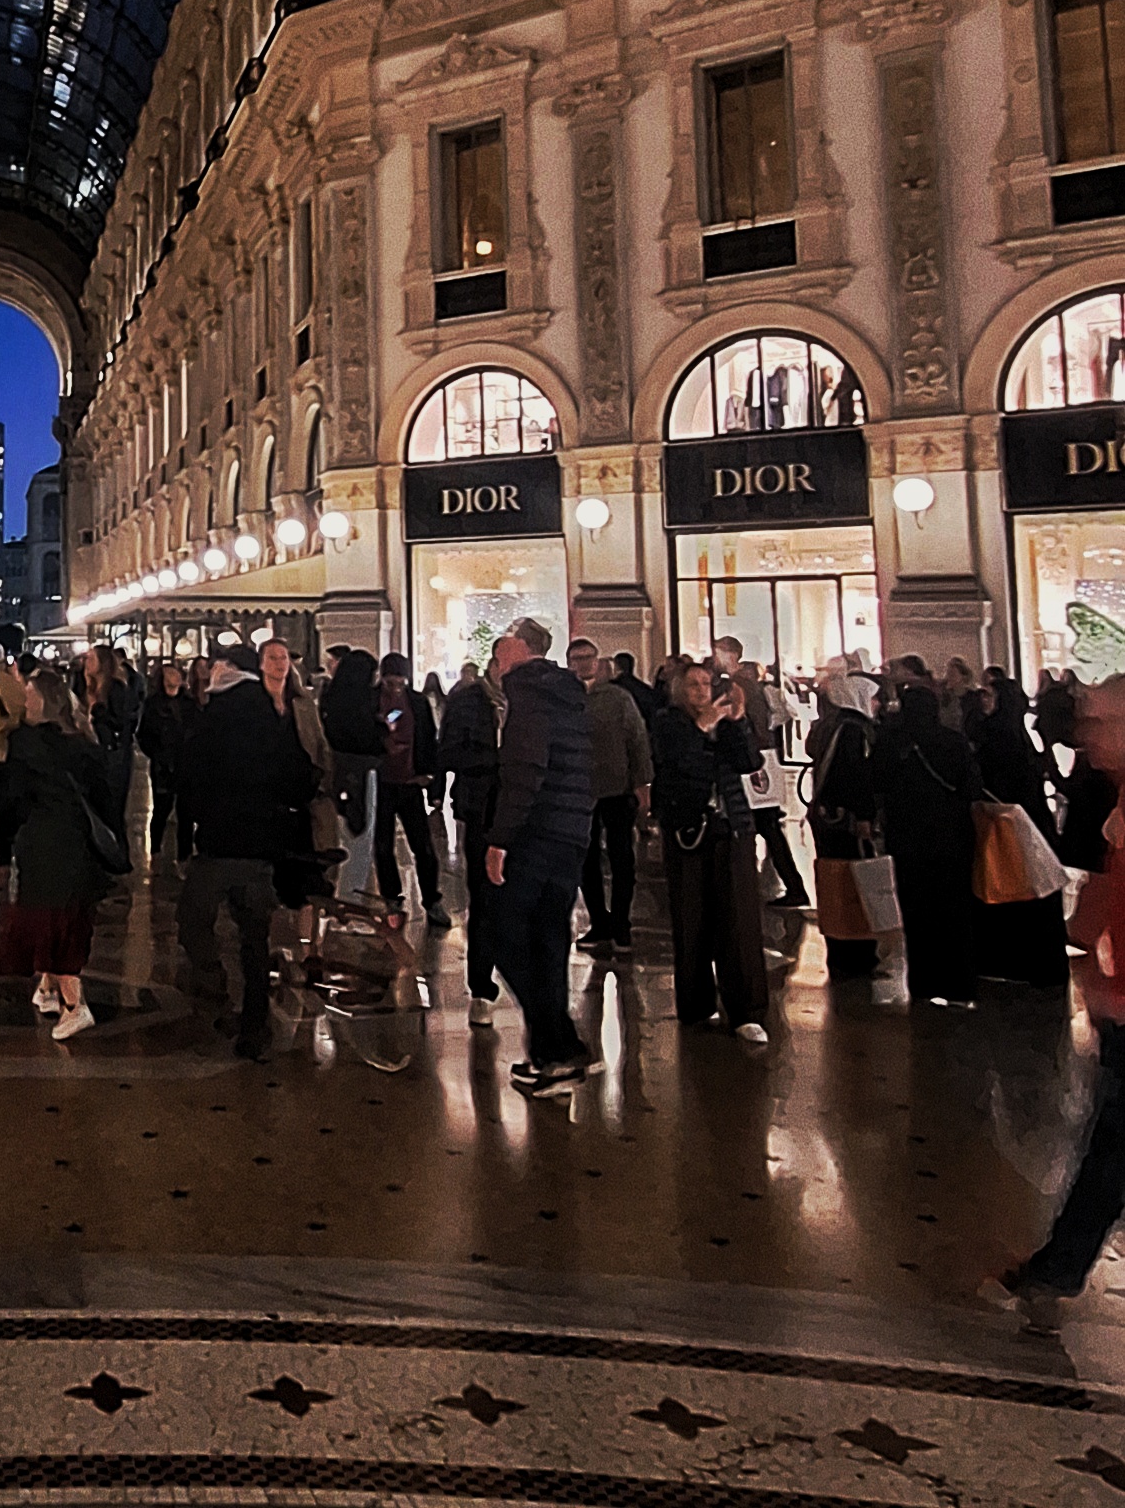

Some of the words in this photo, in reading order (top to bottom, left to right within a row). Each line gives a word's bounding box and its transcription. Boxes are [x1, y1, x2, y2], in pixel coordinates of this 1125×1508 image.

[1064, 440, 1125, 475] DI
[713, 463, 817, 497] DIOR
[442, 484, 521, 515] DIOR
